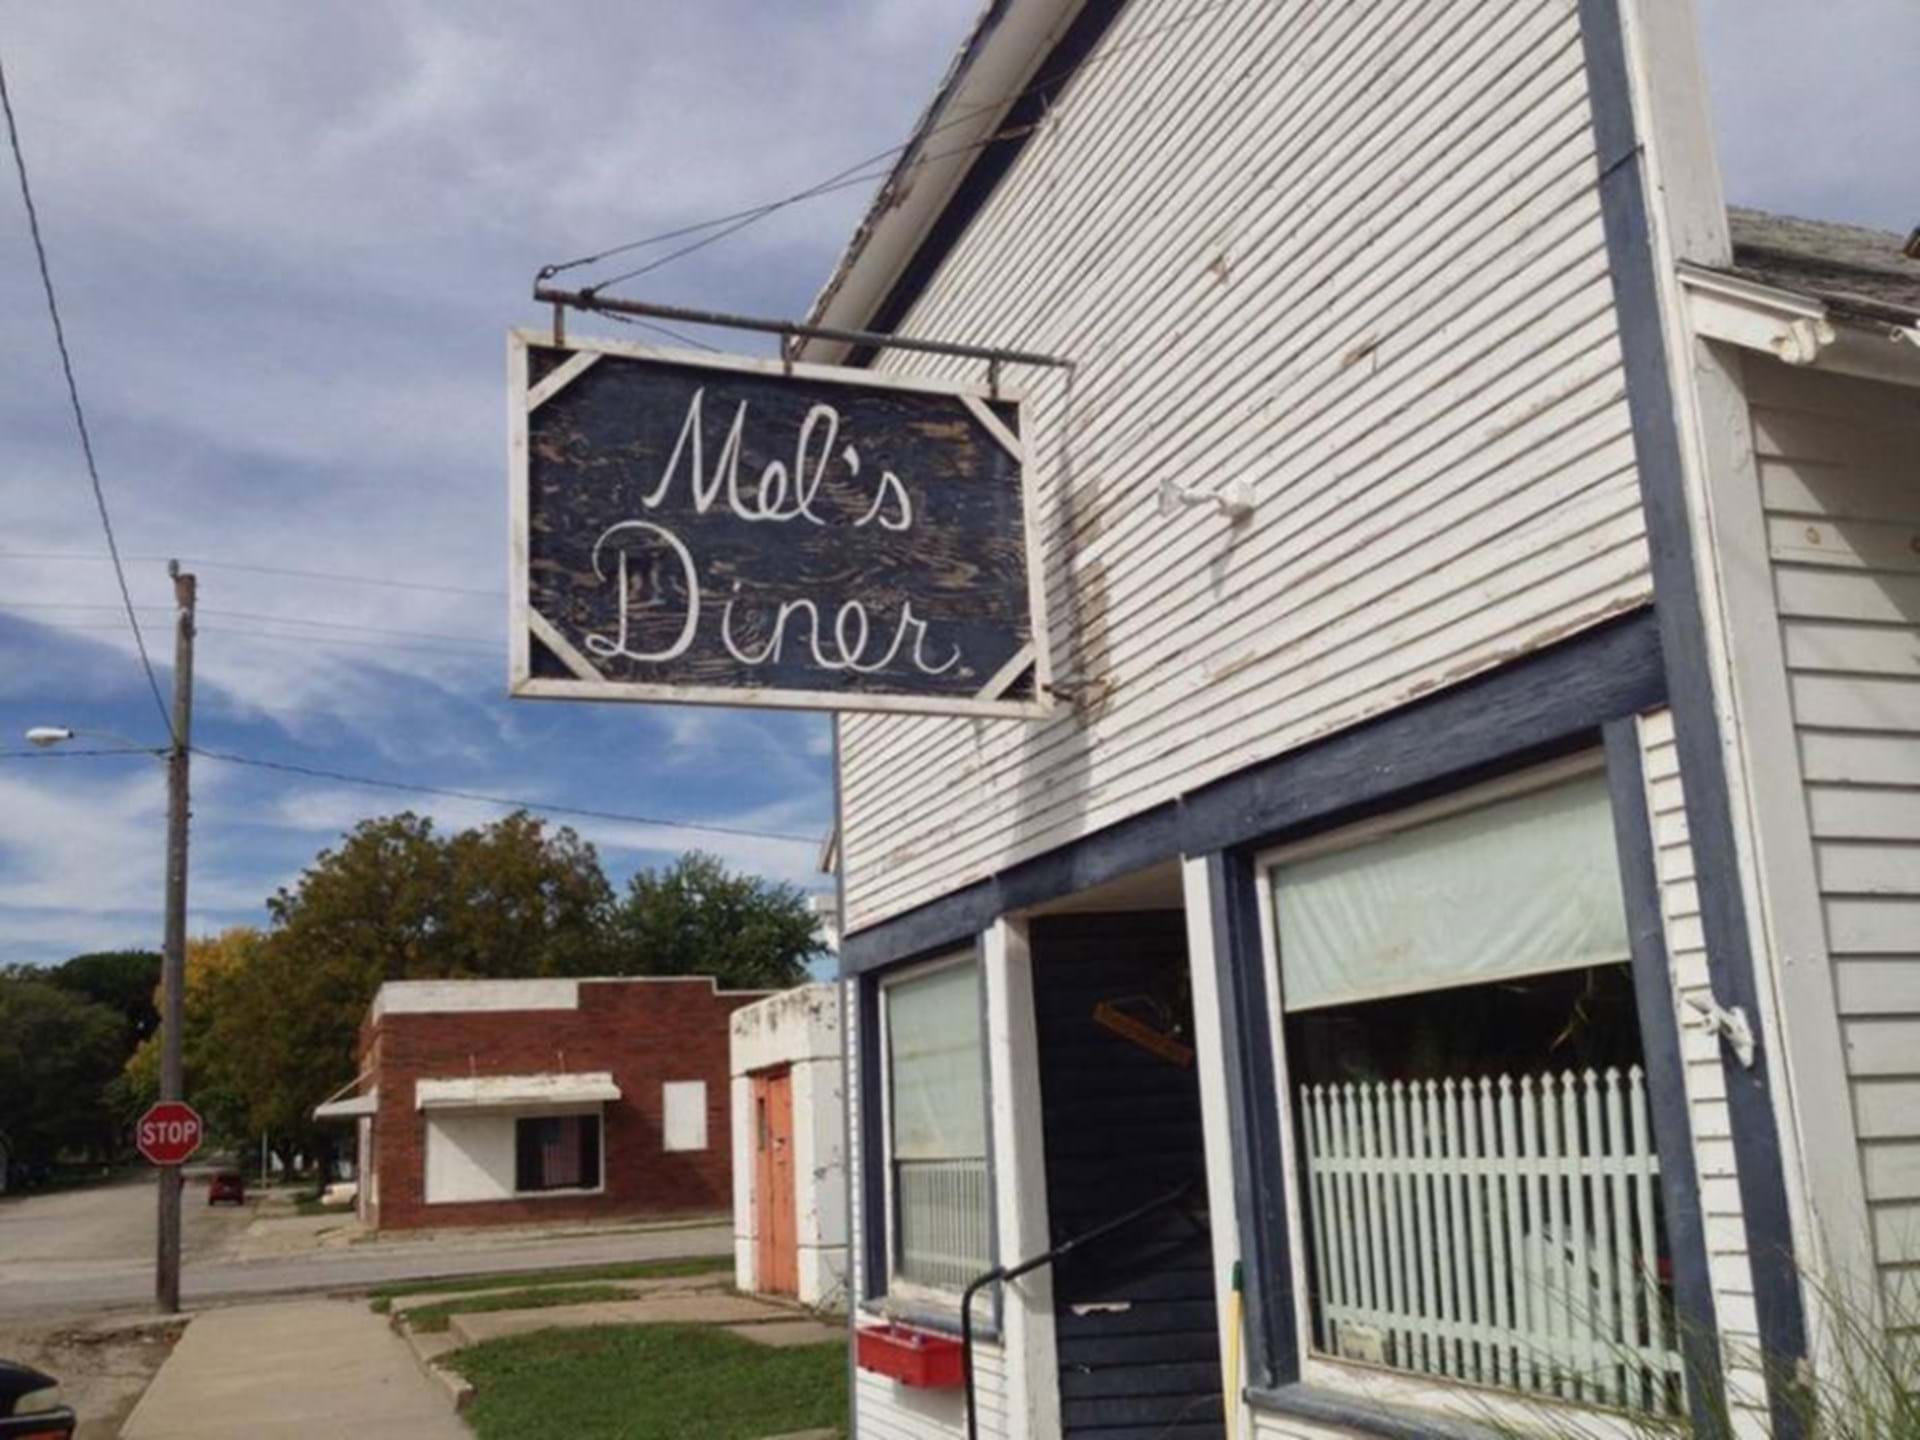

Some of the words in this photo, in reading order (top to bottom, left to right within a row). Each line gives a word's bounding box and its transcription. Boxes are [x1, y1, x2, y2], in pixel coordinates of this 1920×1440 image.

[642, 387, 912, 531] Mel's
[585, 520, 960, 674] Diner
[142, 1121, 198, 1145] STOP
